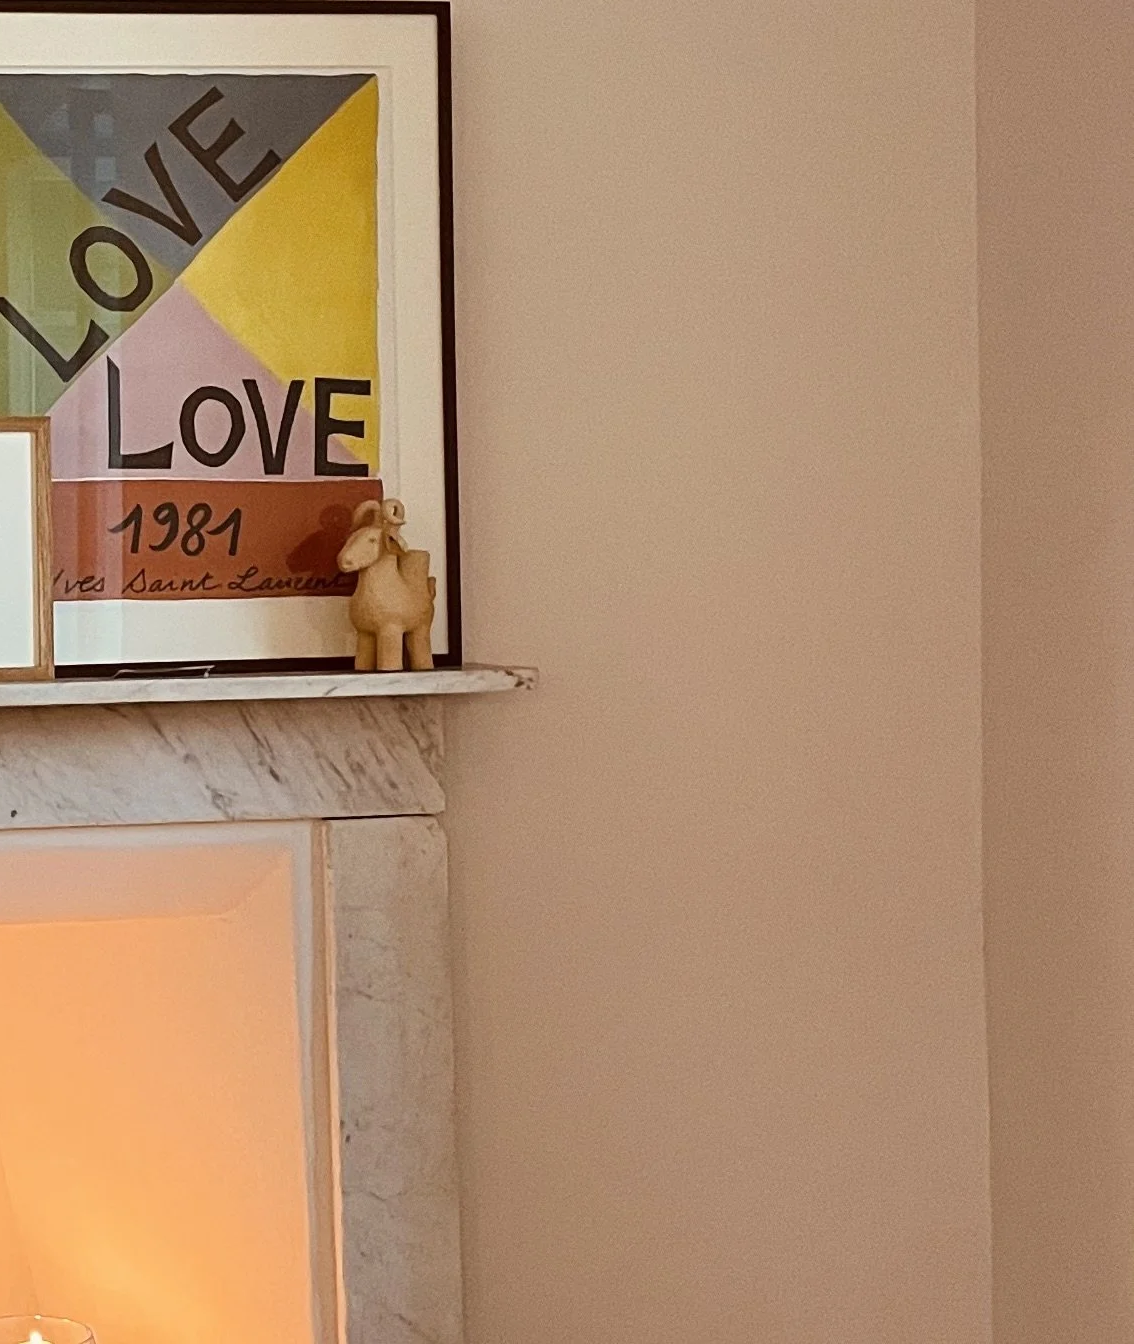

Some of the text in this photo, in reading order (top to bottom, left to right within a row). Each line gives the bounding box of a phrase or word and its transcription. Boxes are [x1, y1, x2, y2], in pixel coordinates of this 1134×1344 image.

[106, 356, 372, 476] LOVE
[108, 502, 242, 556] 1981
[121, 567, 218, 594] Saint
